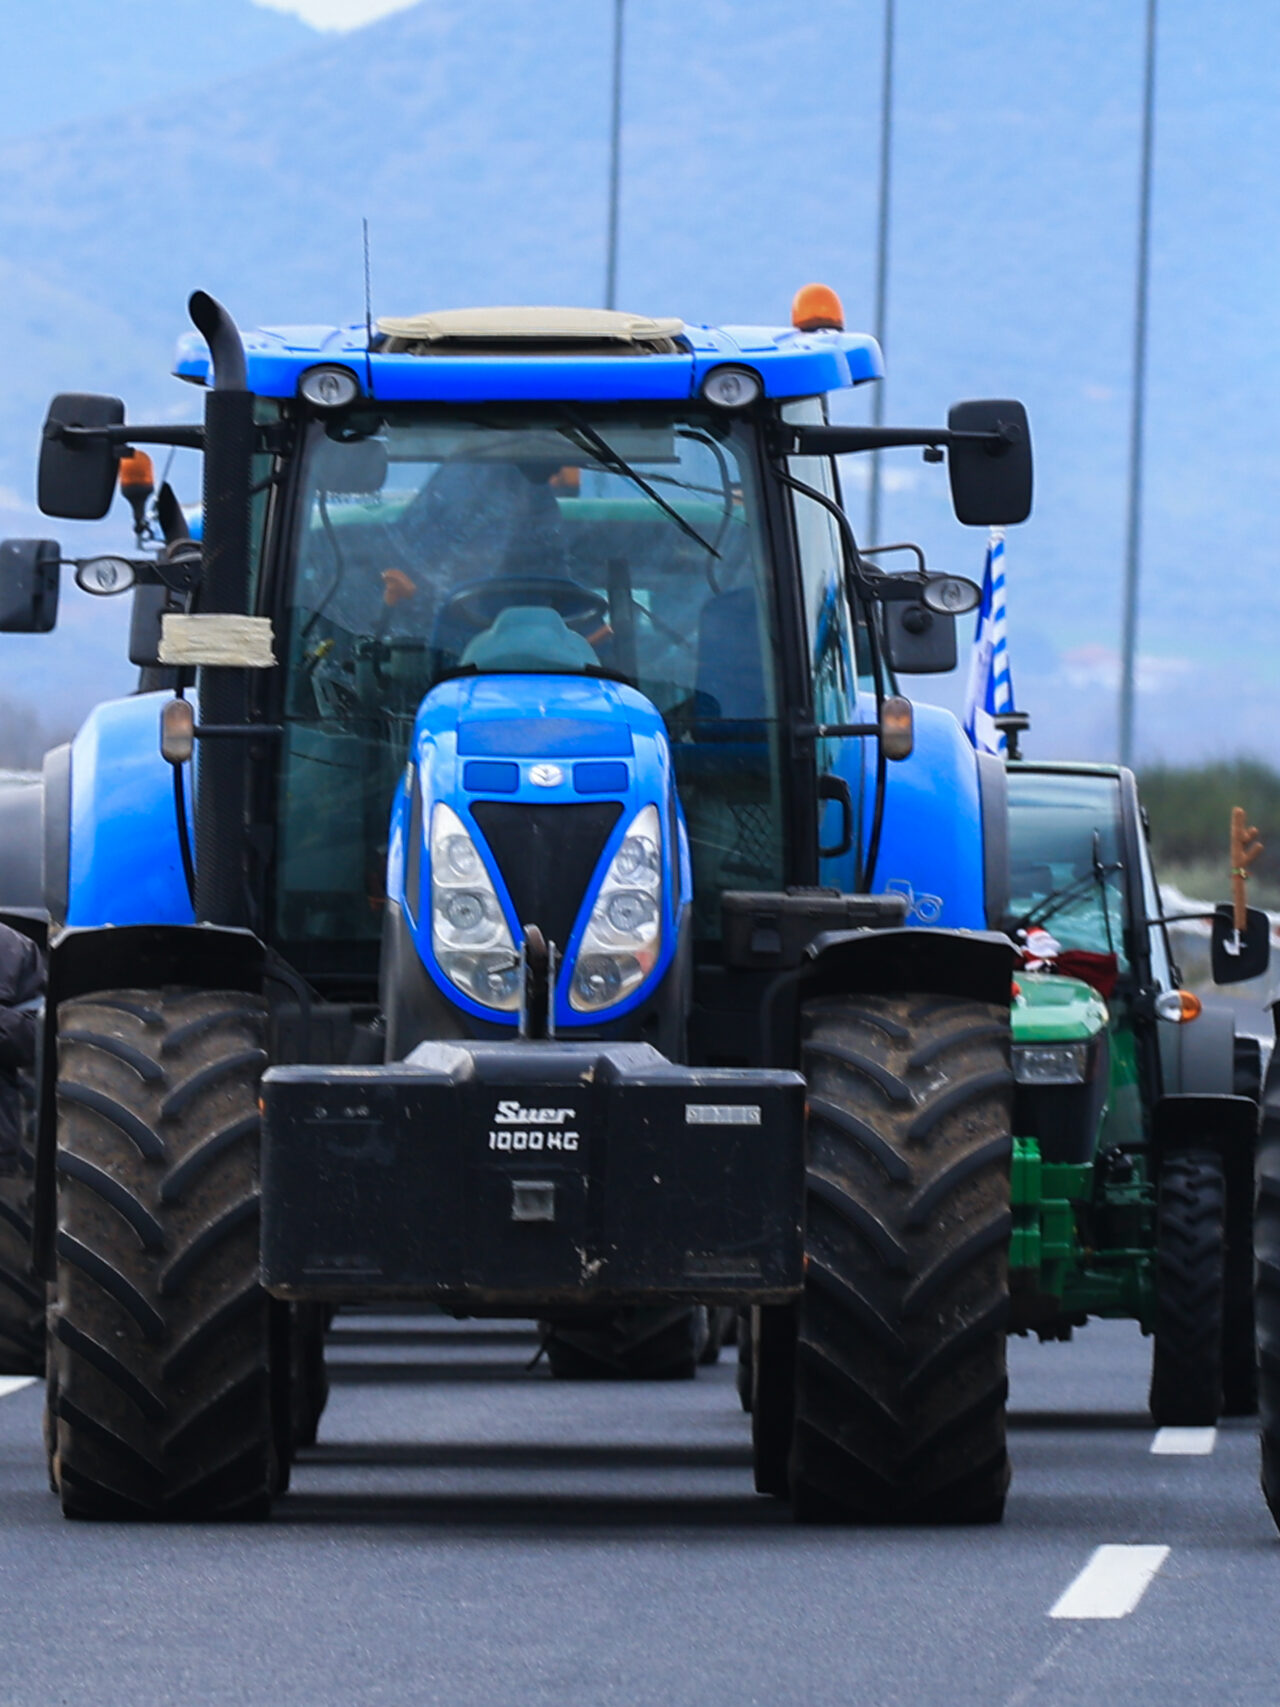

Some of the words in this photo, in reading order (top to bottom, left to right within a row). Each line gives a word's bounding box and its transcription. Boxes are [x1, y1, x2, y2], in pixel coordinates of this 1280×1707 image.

[494, 1100, 577, 1125] Suer
[489, 1131, 544, 1151] 1000
[546, 1131, 580, 1151] KG
